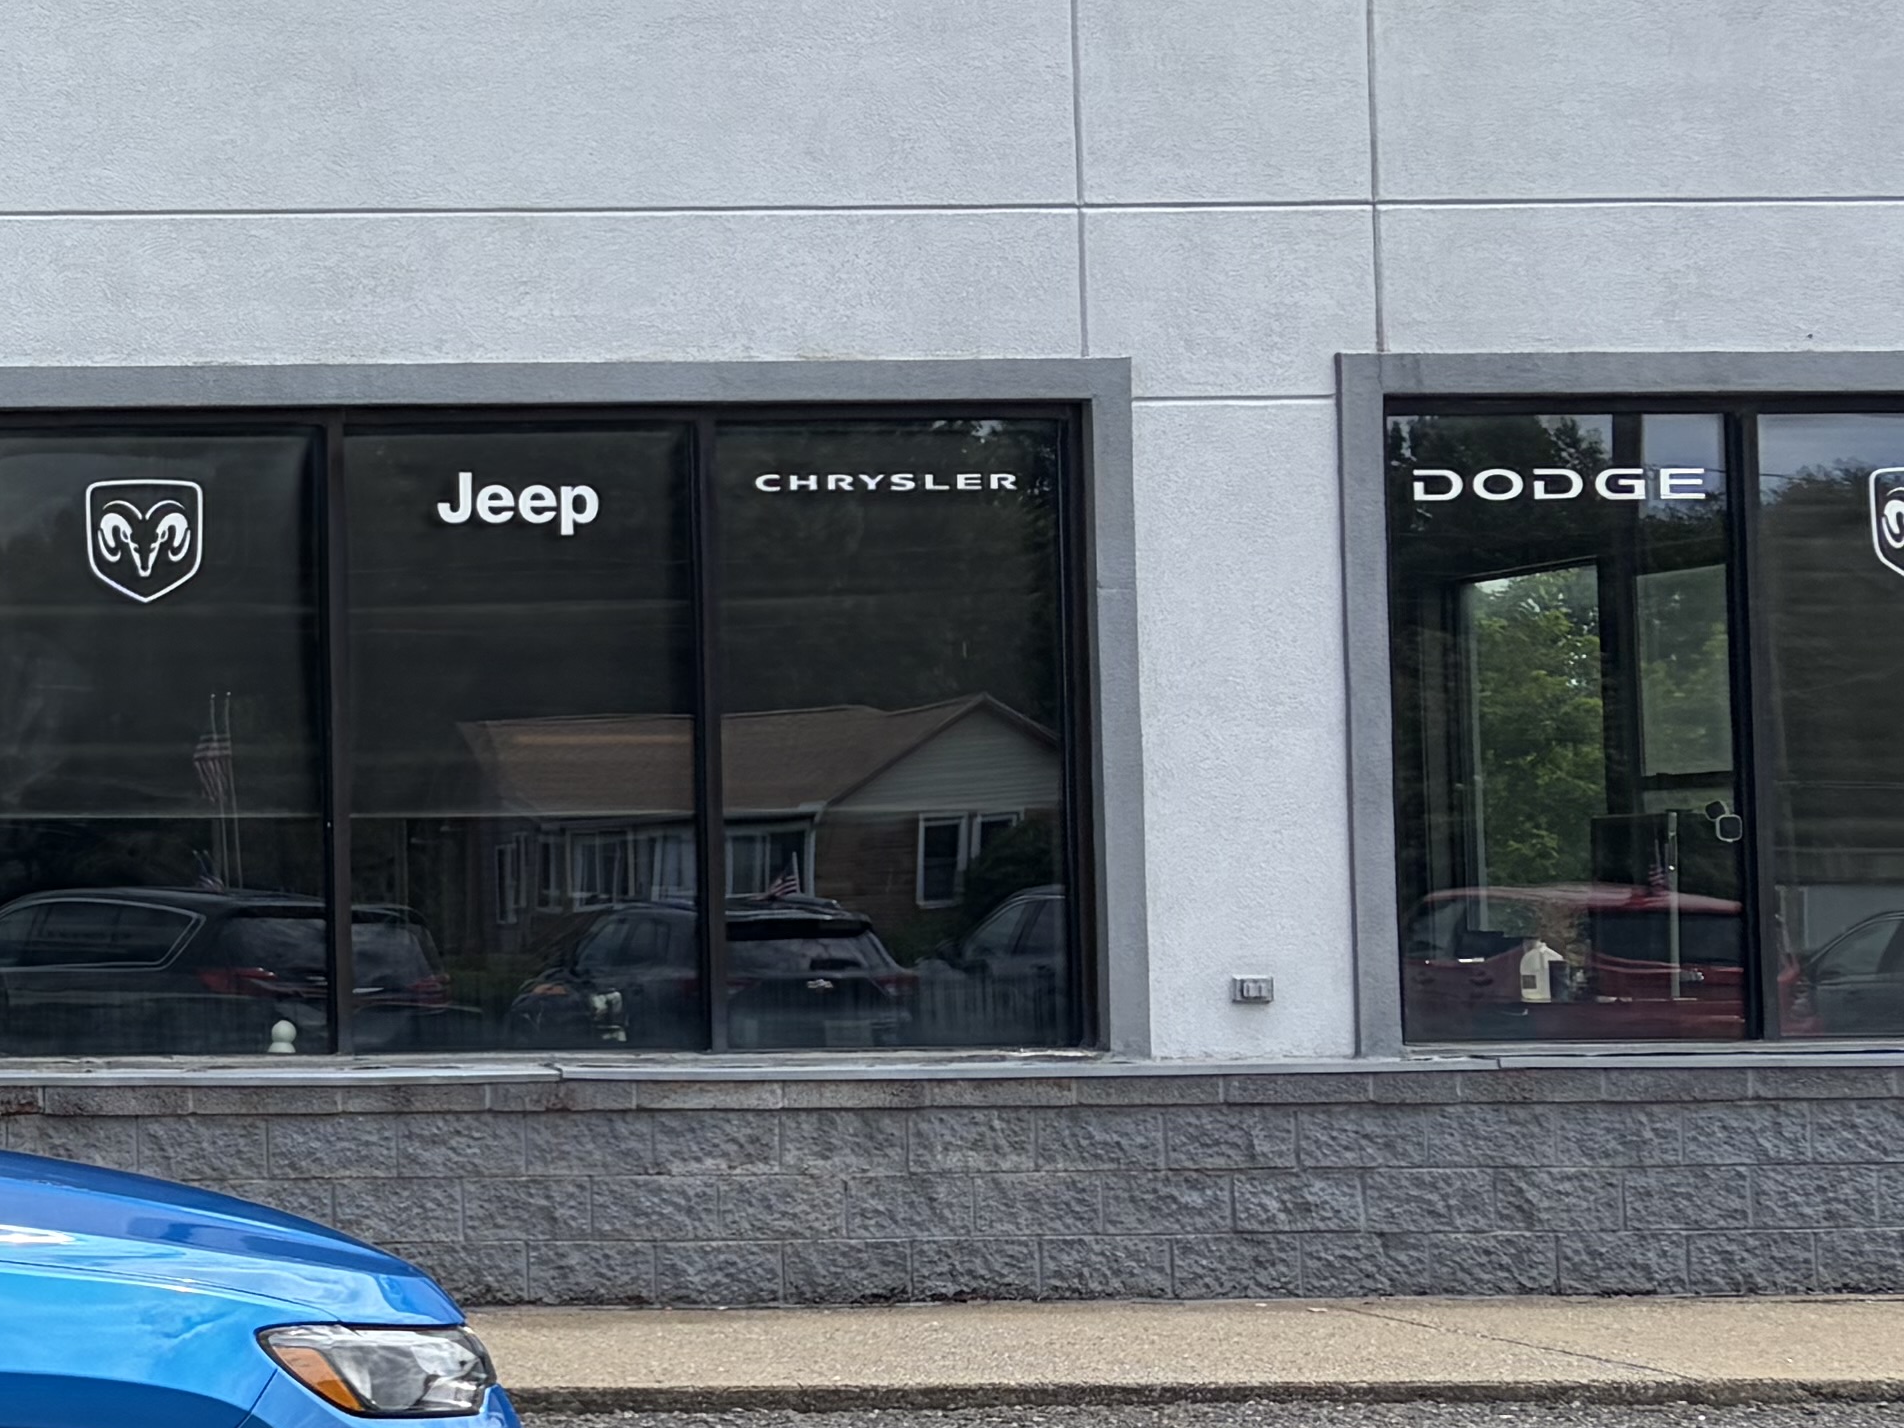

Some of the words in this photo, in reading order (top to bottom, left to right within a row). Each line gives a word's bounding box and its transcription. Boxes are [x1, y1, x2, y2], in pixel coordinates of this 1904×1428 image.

[755, 473, 1018, 492] CHRYSLER
[1413, 468, 1705, 501] DODGE
[437, 472, 599, 536] Jeep
